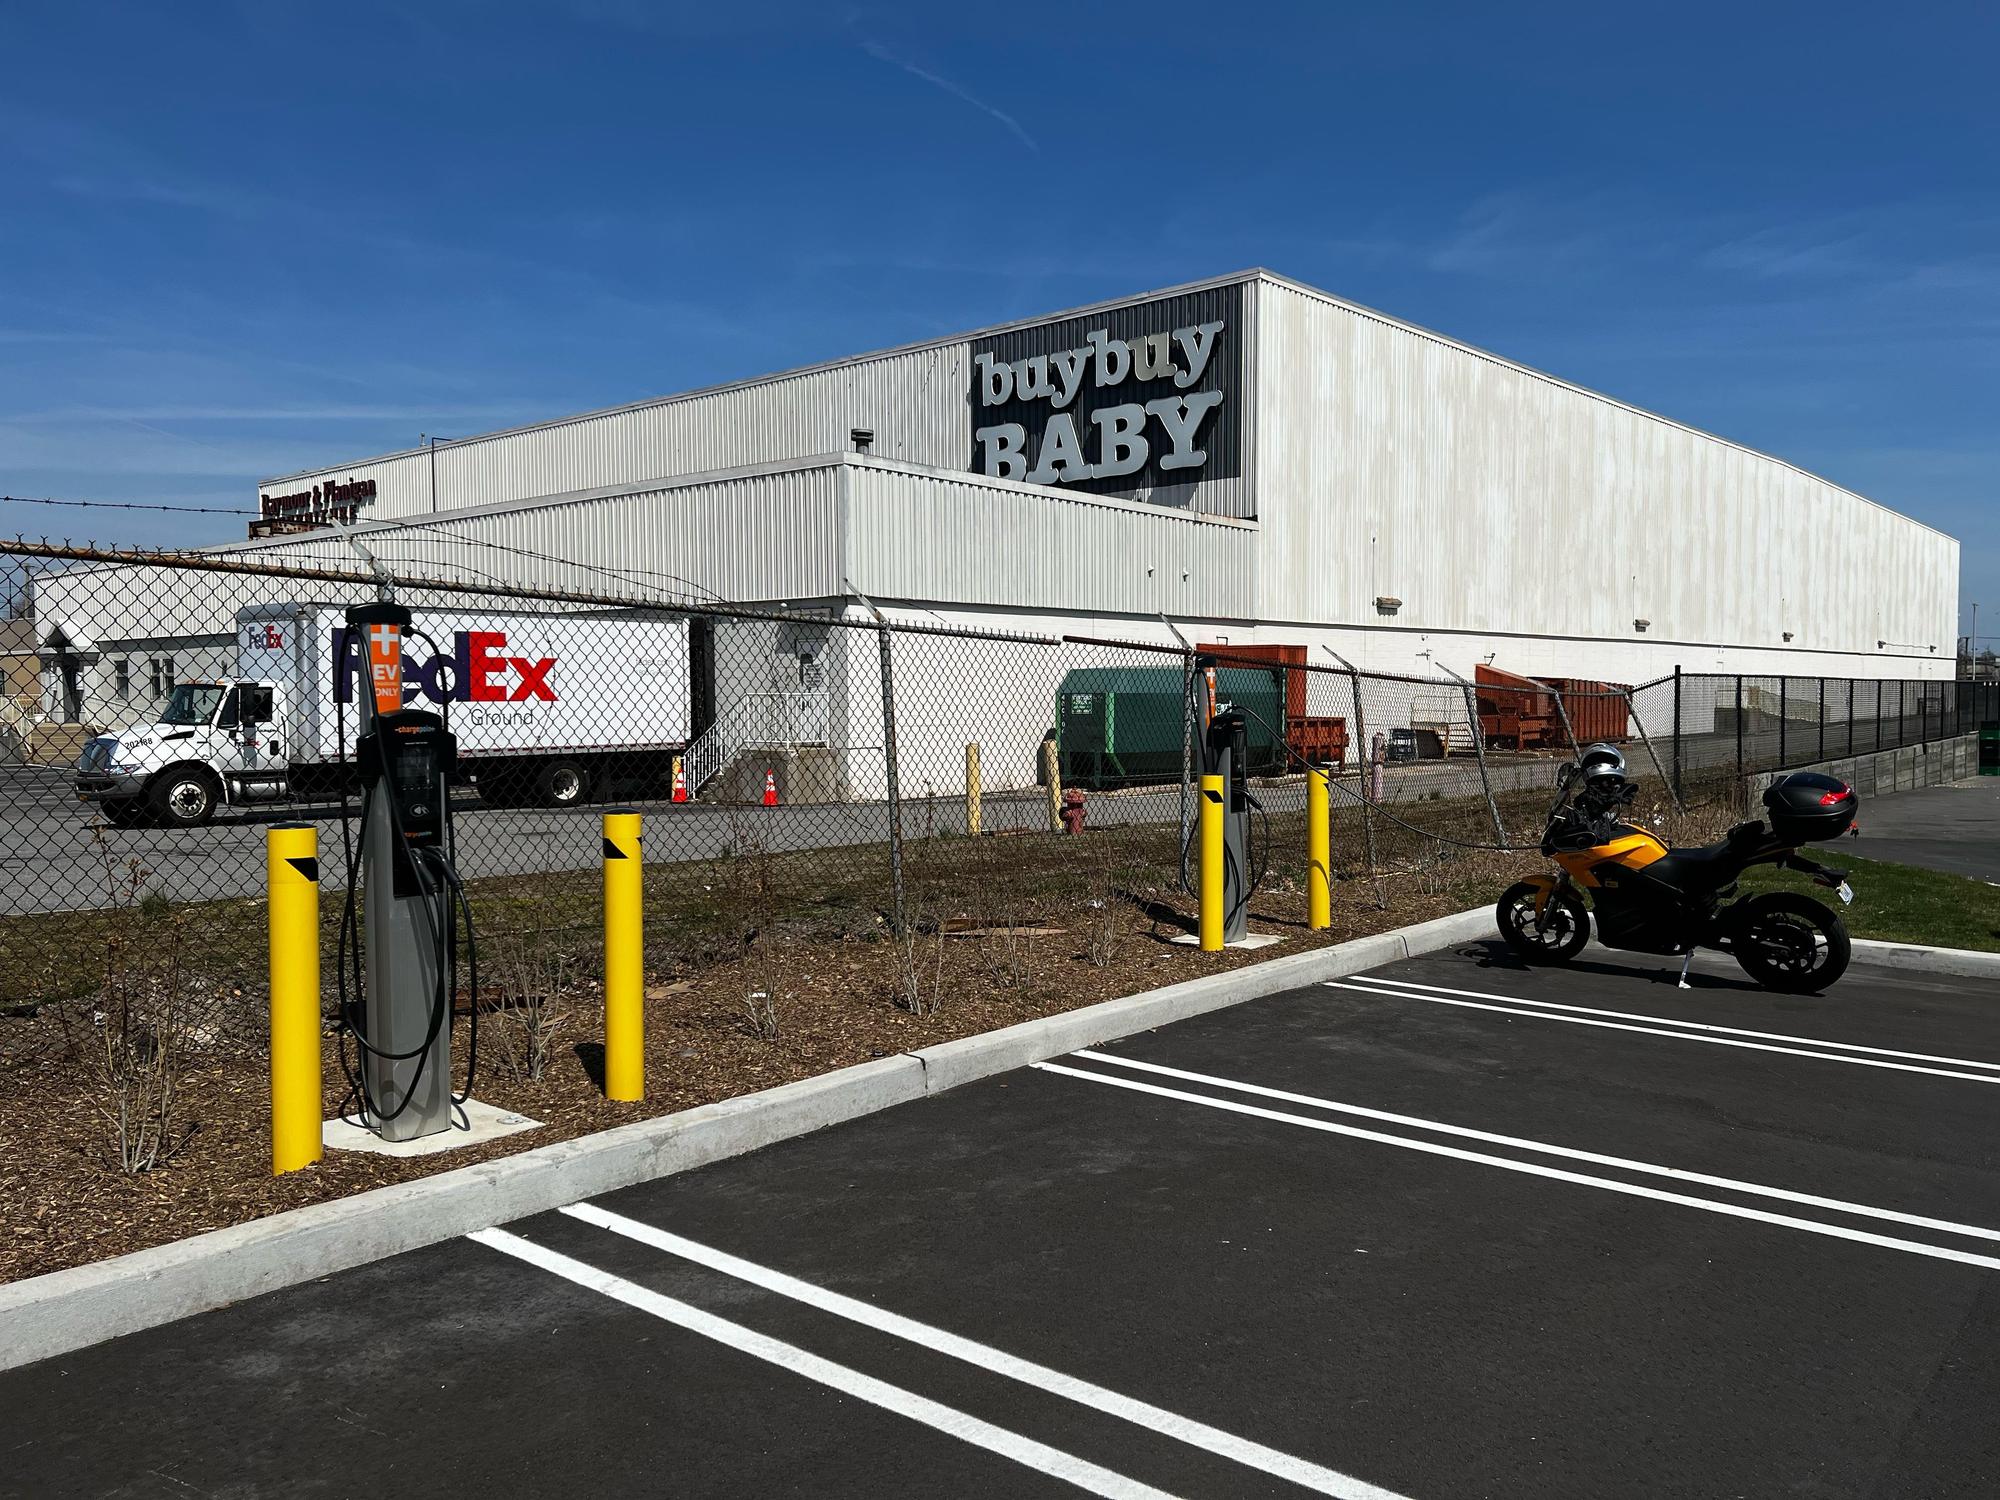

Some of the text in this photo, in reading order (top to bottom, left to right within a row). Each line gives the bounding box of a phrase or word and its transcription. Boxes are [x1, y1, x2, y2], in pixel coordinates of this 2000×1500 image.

[975, 320, 1225, 409] buybuy
[976, 389, 1223, 484] BABY
[261, 477, 376, 515] Raymour & Flanigan
[248, 625, 284, 650] FedEx
[373, 664, 398, 680] EV
[375, 687, 399, 697] ONLY
[471, 708, 533, 726] Ground
